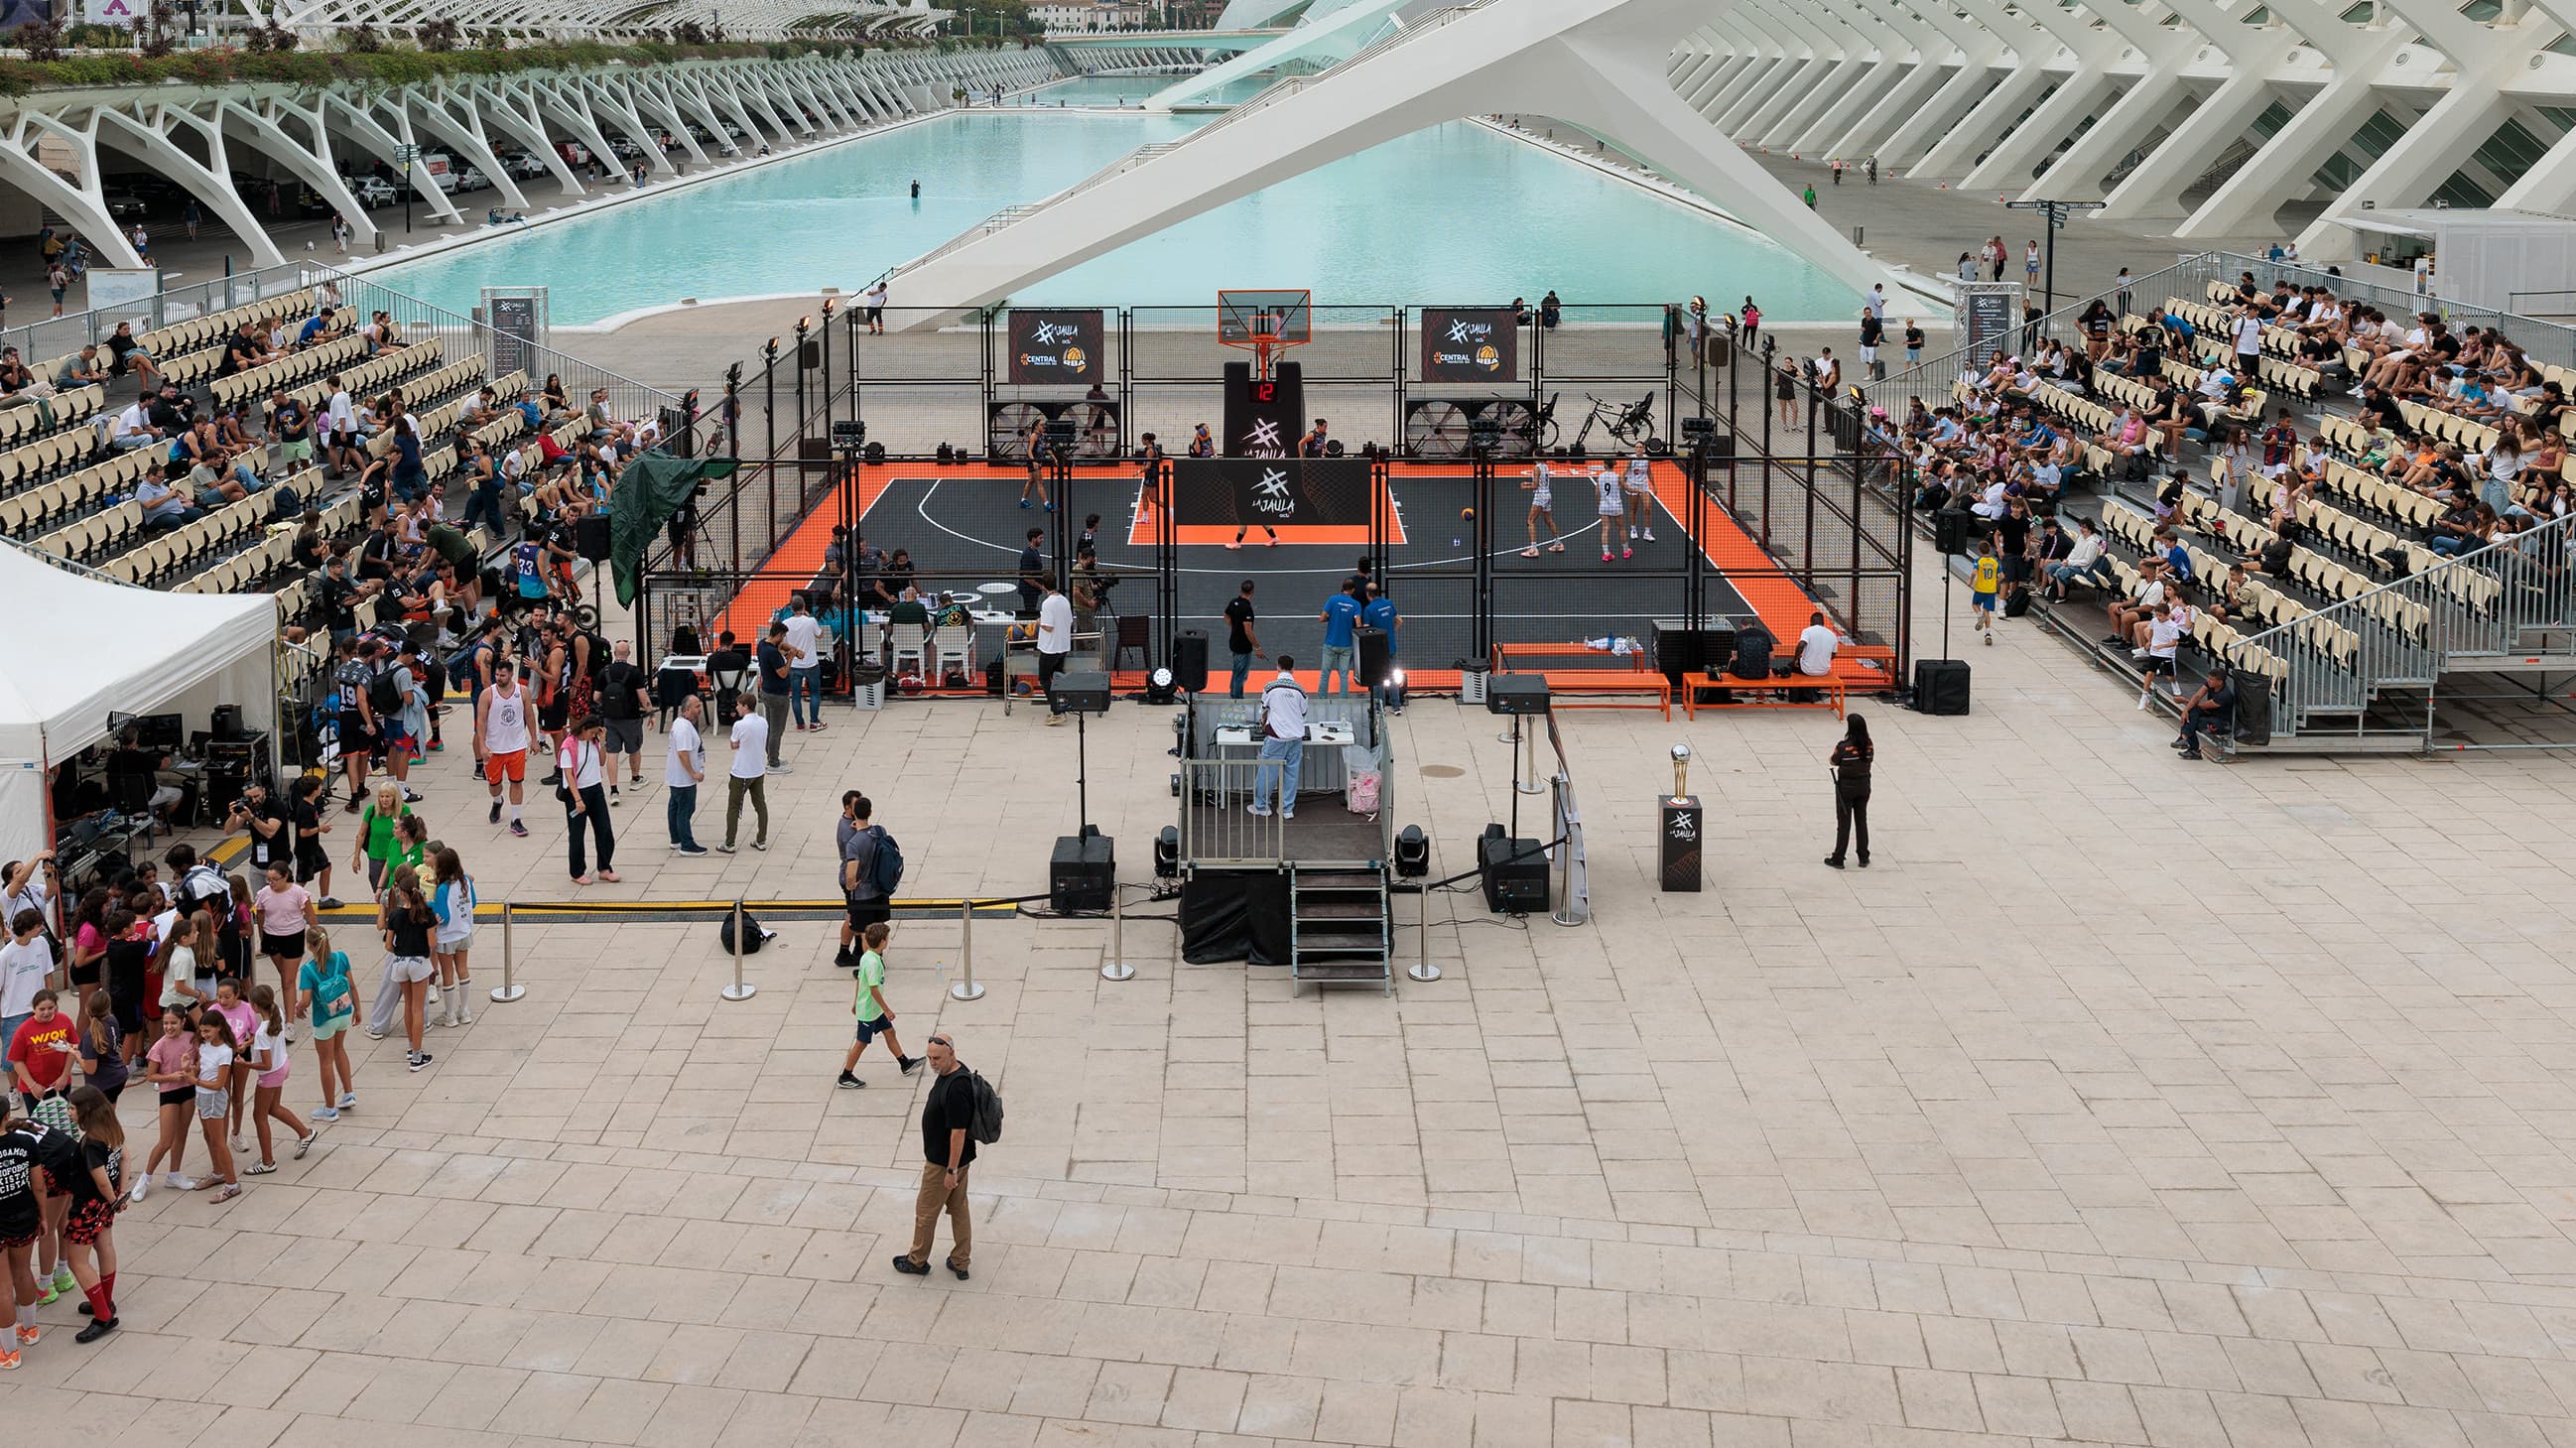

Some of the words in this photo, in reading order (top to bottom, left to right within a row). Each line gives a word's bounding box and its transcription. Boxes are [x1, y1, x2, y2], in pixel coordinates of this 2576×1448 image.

[1259, 383, 1274, 401] 12
[1604, 482, 1611, 496] 9
[1260, 498, 1295, 513] JAULA
[518, 558, 534, 576] 33
[1984, 568, 1993, 581] 10
[392, 588, 403, 597] 15
[339, 684, 357, 706] 19
[1675, 830, 1696, 840] JAULA
